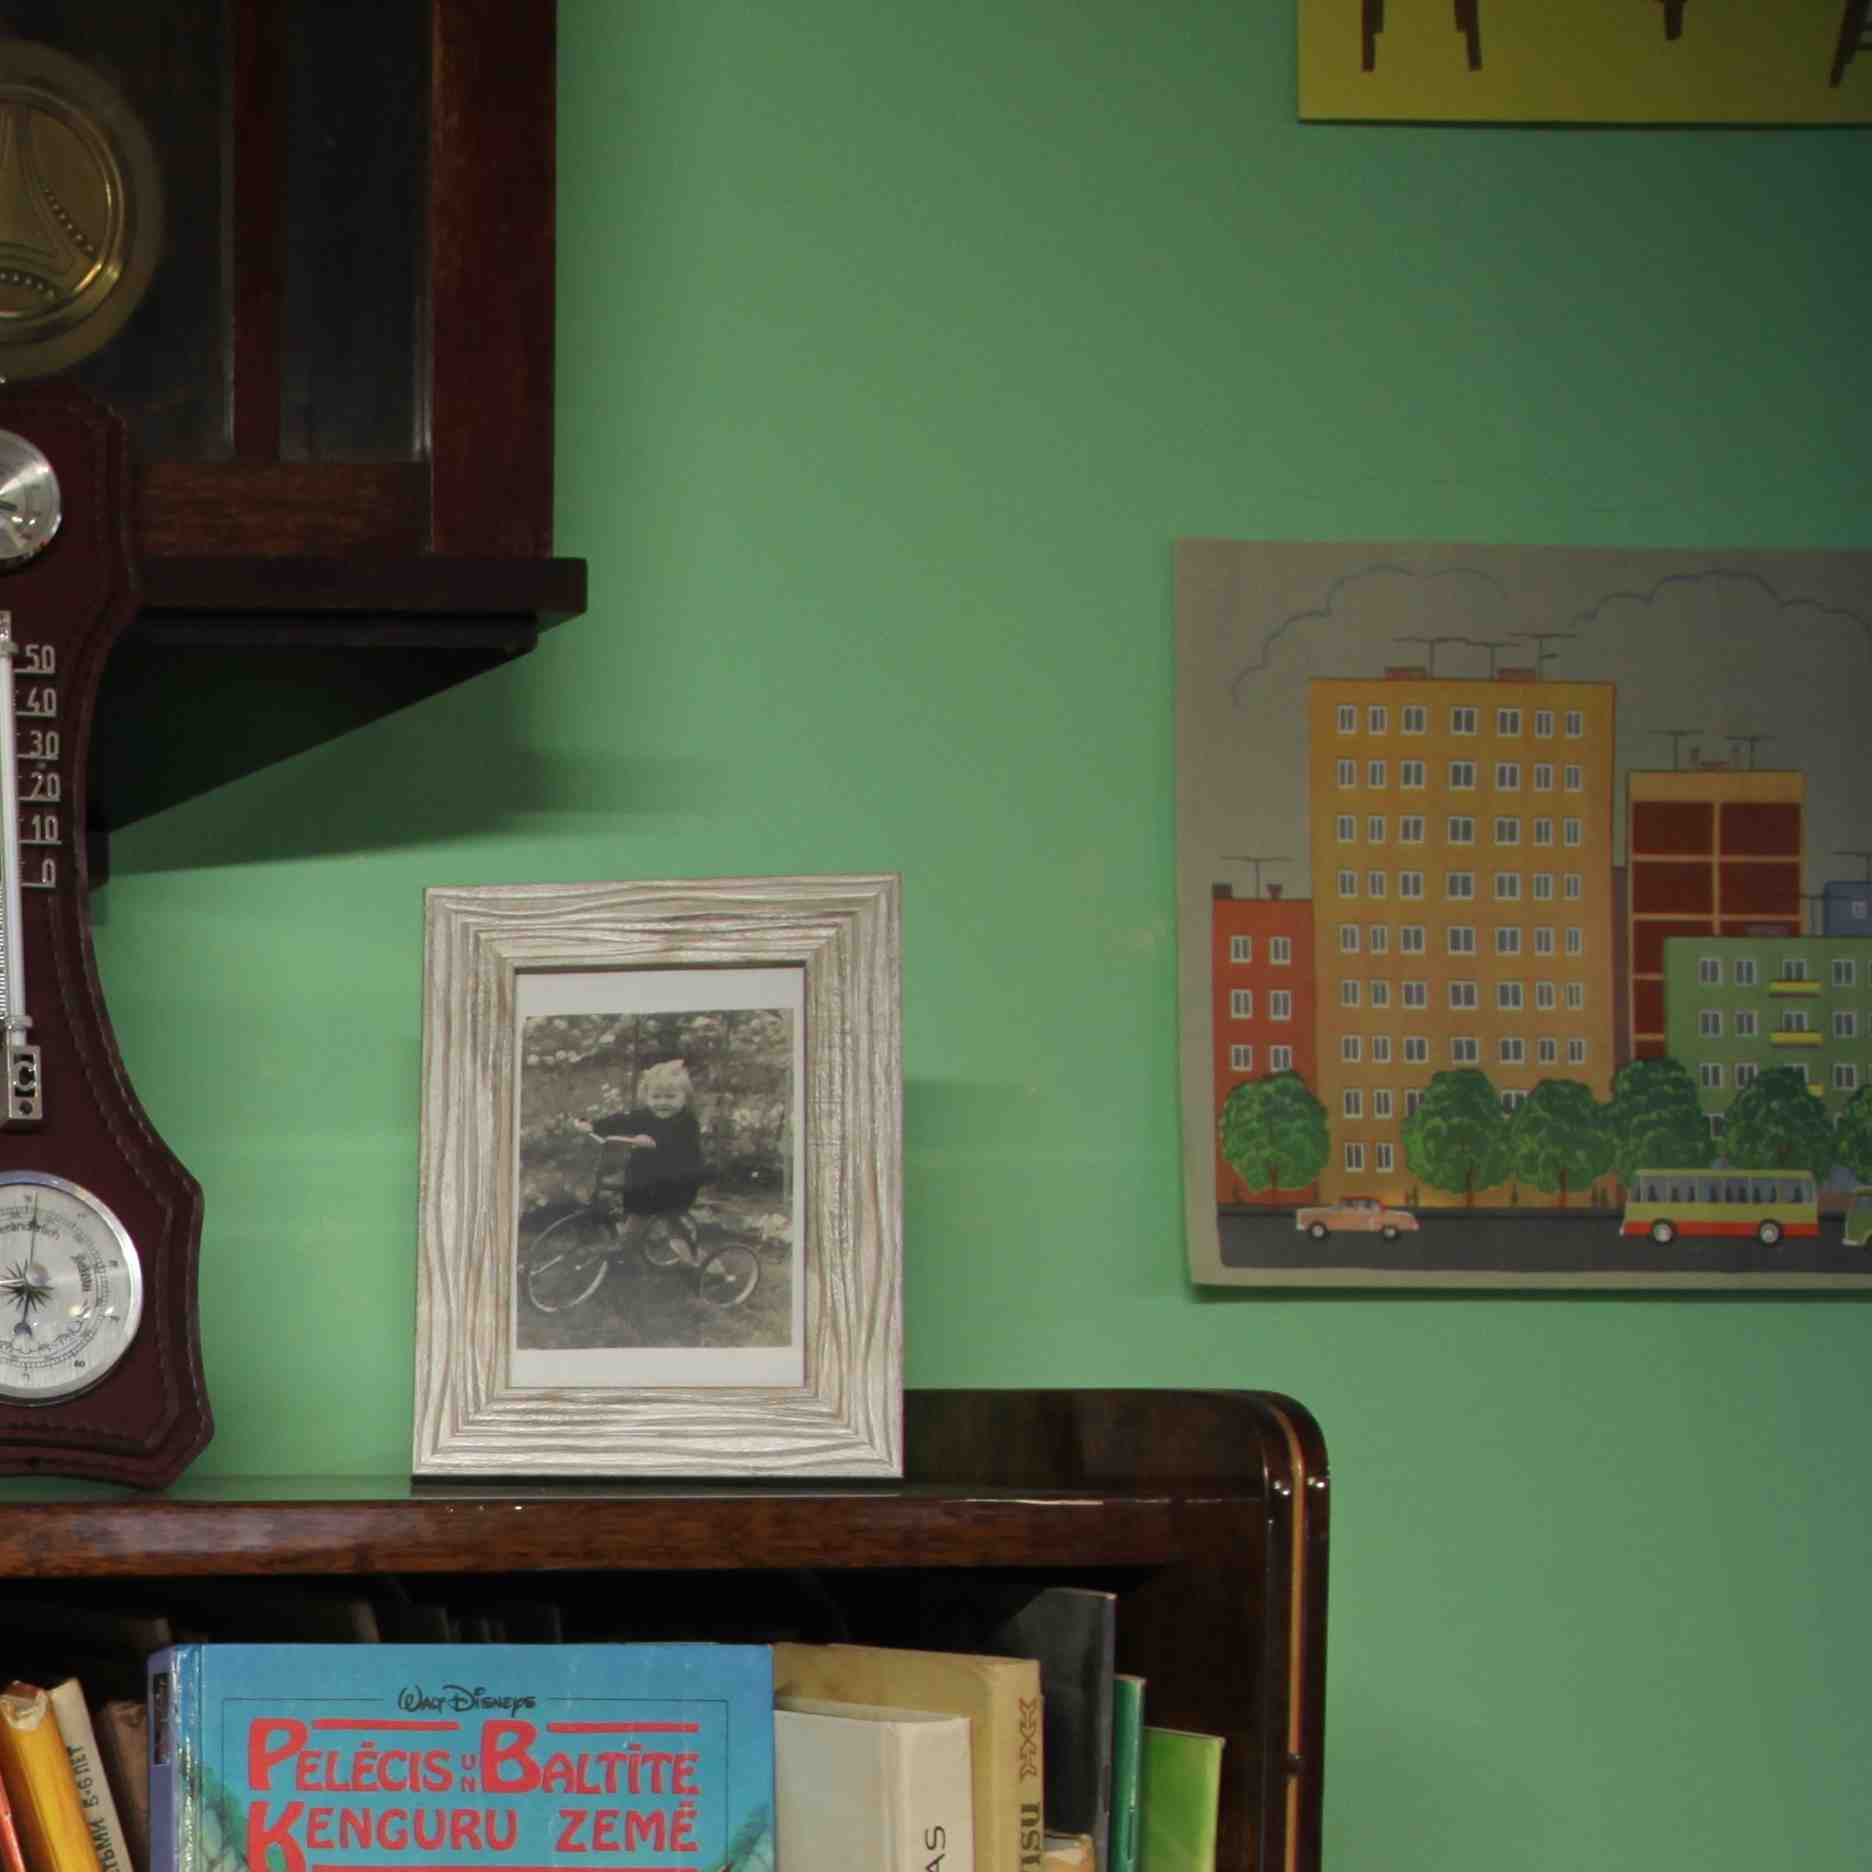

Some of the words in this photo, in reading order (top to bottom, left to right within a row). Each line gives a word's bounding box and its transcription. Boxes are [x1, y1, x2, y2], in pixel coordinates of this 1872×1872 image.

[24, 646, 55, 671] 50
[25, 690, 56, 713] 40
[30, 732, 60, 757] 30
[30, 774, 60, 798] 20
[32, 818, 59, 841] 10
[42, 859, 55, 884] 0
[247, 1718, 453, 1792] PELĒCIS
[481, 1719, 700, 1796] BALTĪTE
[557, 1802, 700, 1853] ZEMĒ
